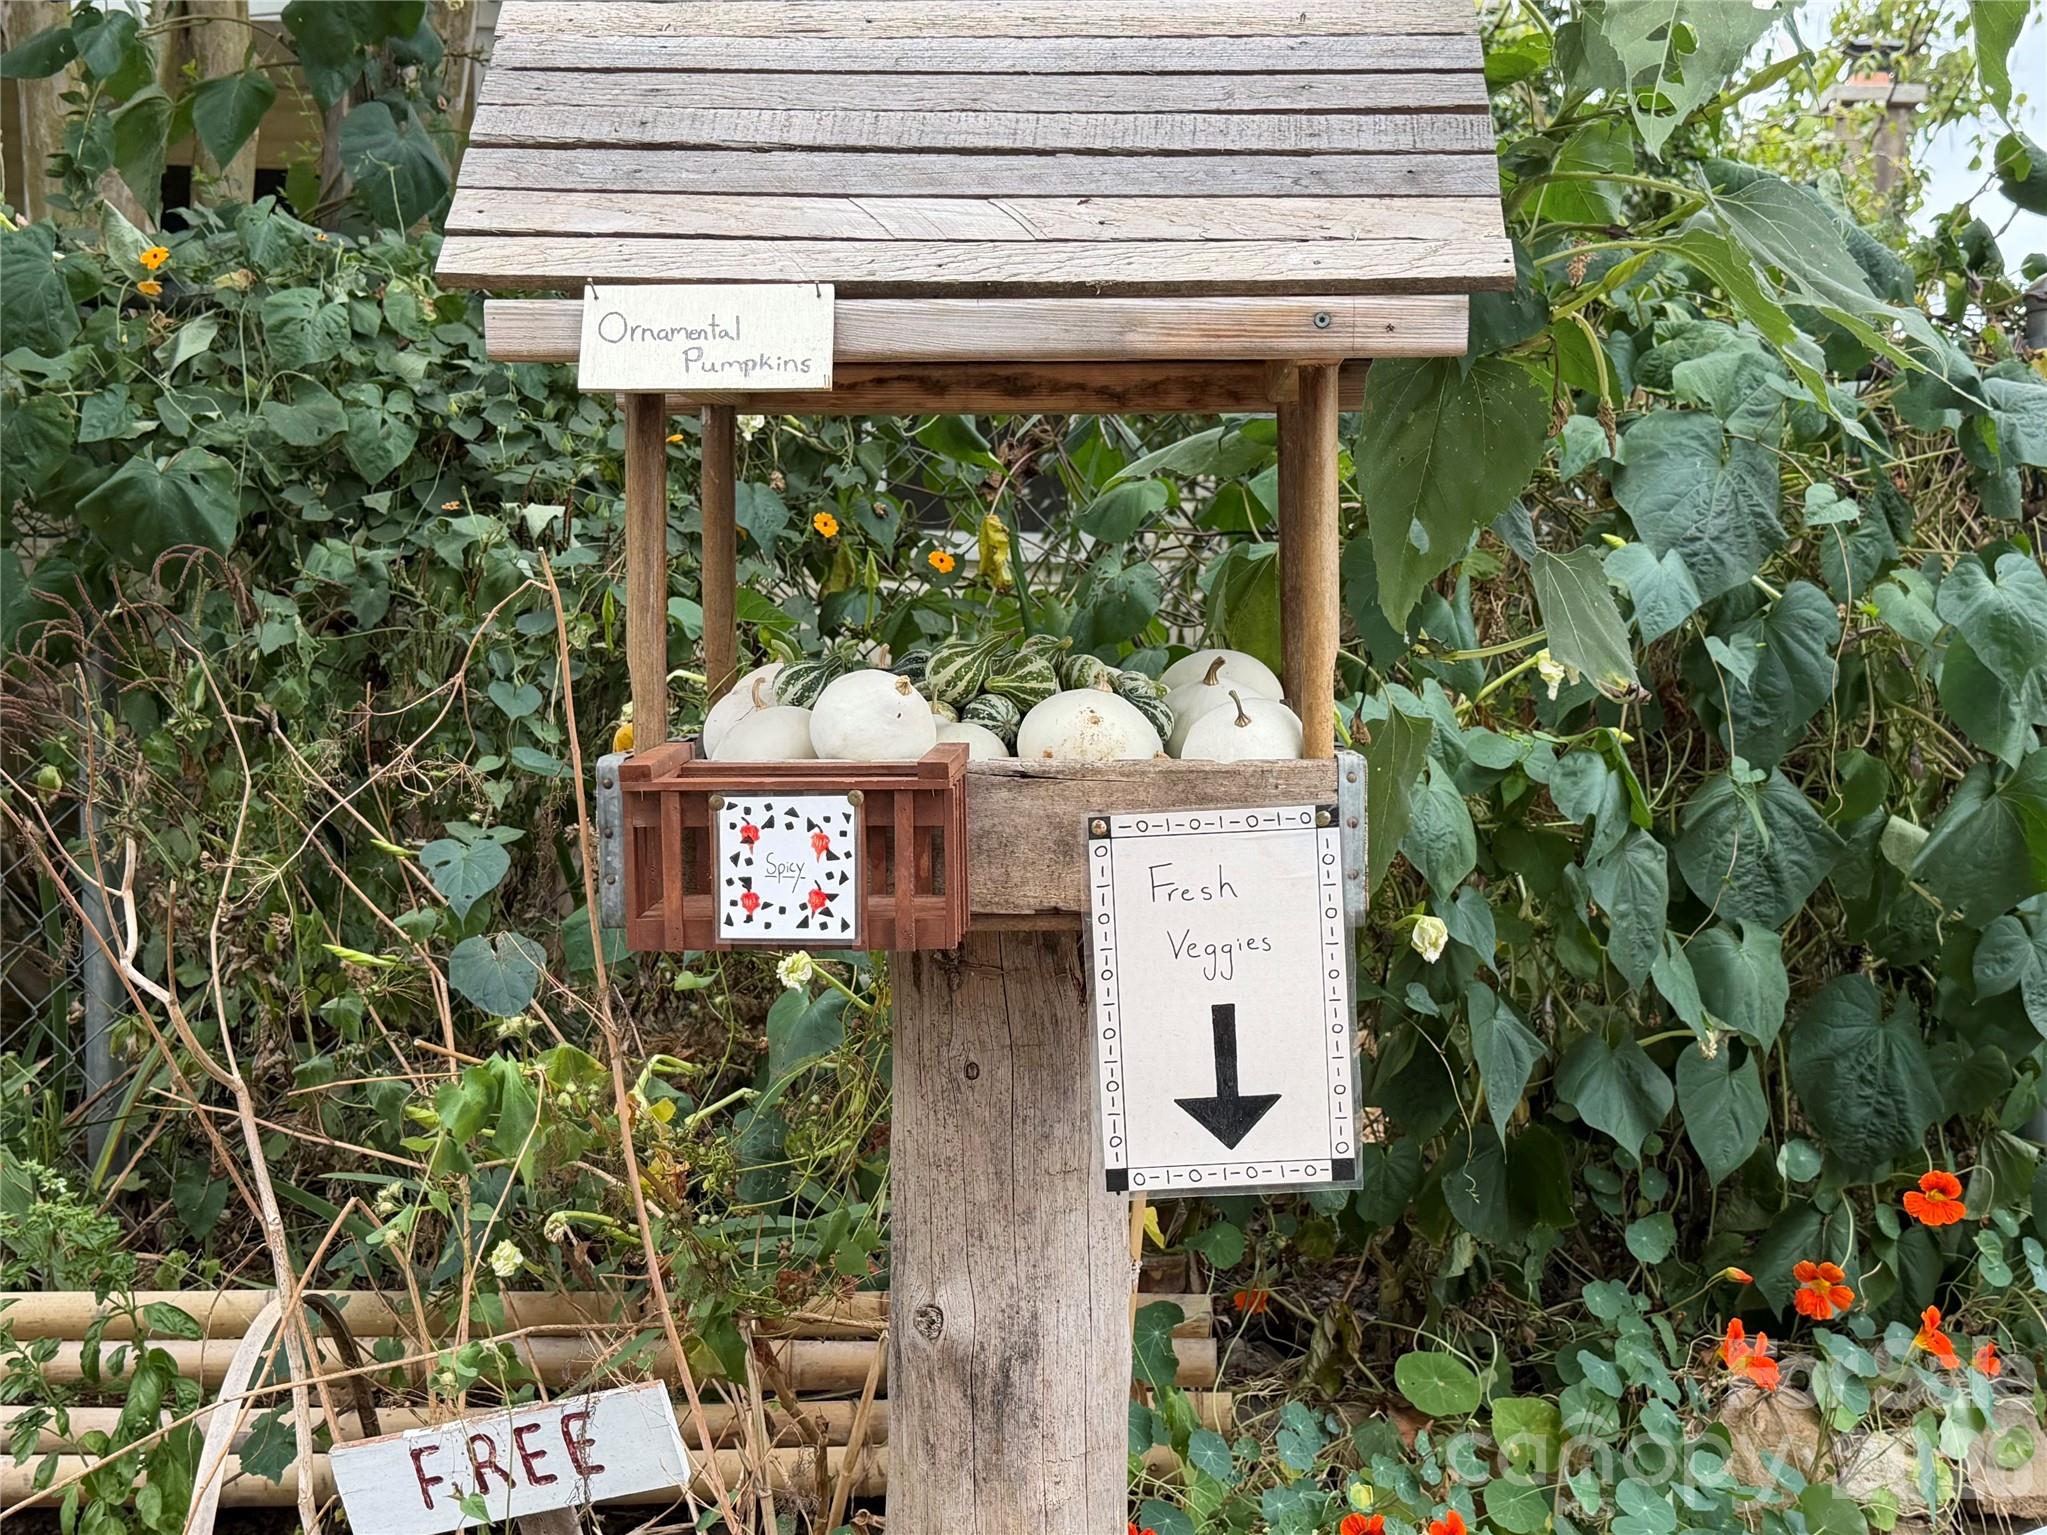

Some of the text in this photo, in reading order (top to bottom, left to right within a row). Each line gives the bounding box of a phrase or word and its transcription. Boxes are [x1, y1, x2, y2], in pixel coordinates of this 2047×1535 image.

[598, 311, 741, 343] Ornamental
[682, 346, 812, 378] Pumpkins
[765, 851, 806, 893] Spicy
[1148, 862, 1239, 903] Fresh
[1166, 928, 1272, 981] Veggies
[409, 1411, 606, 1511] FREE
